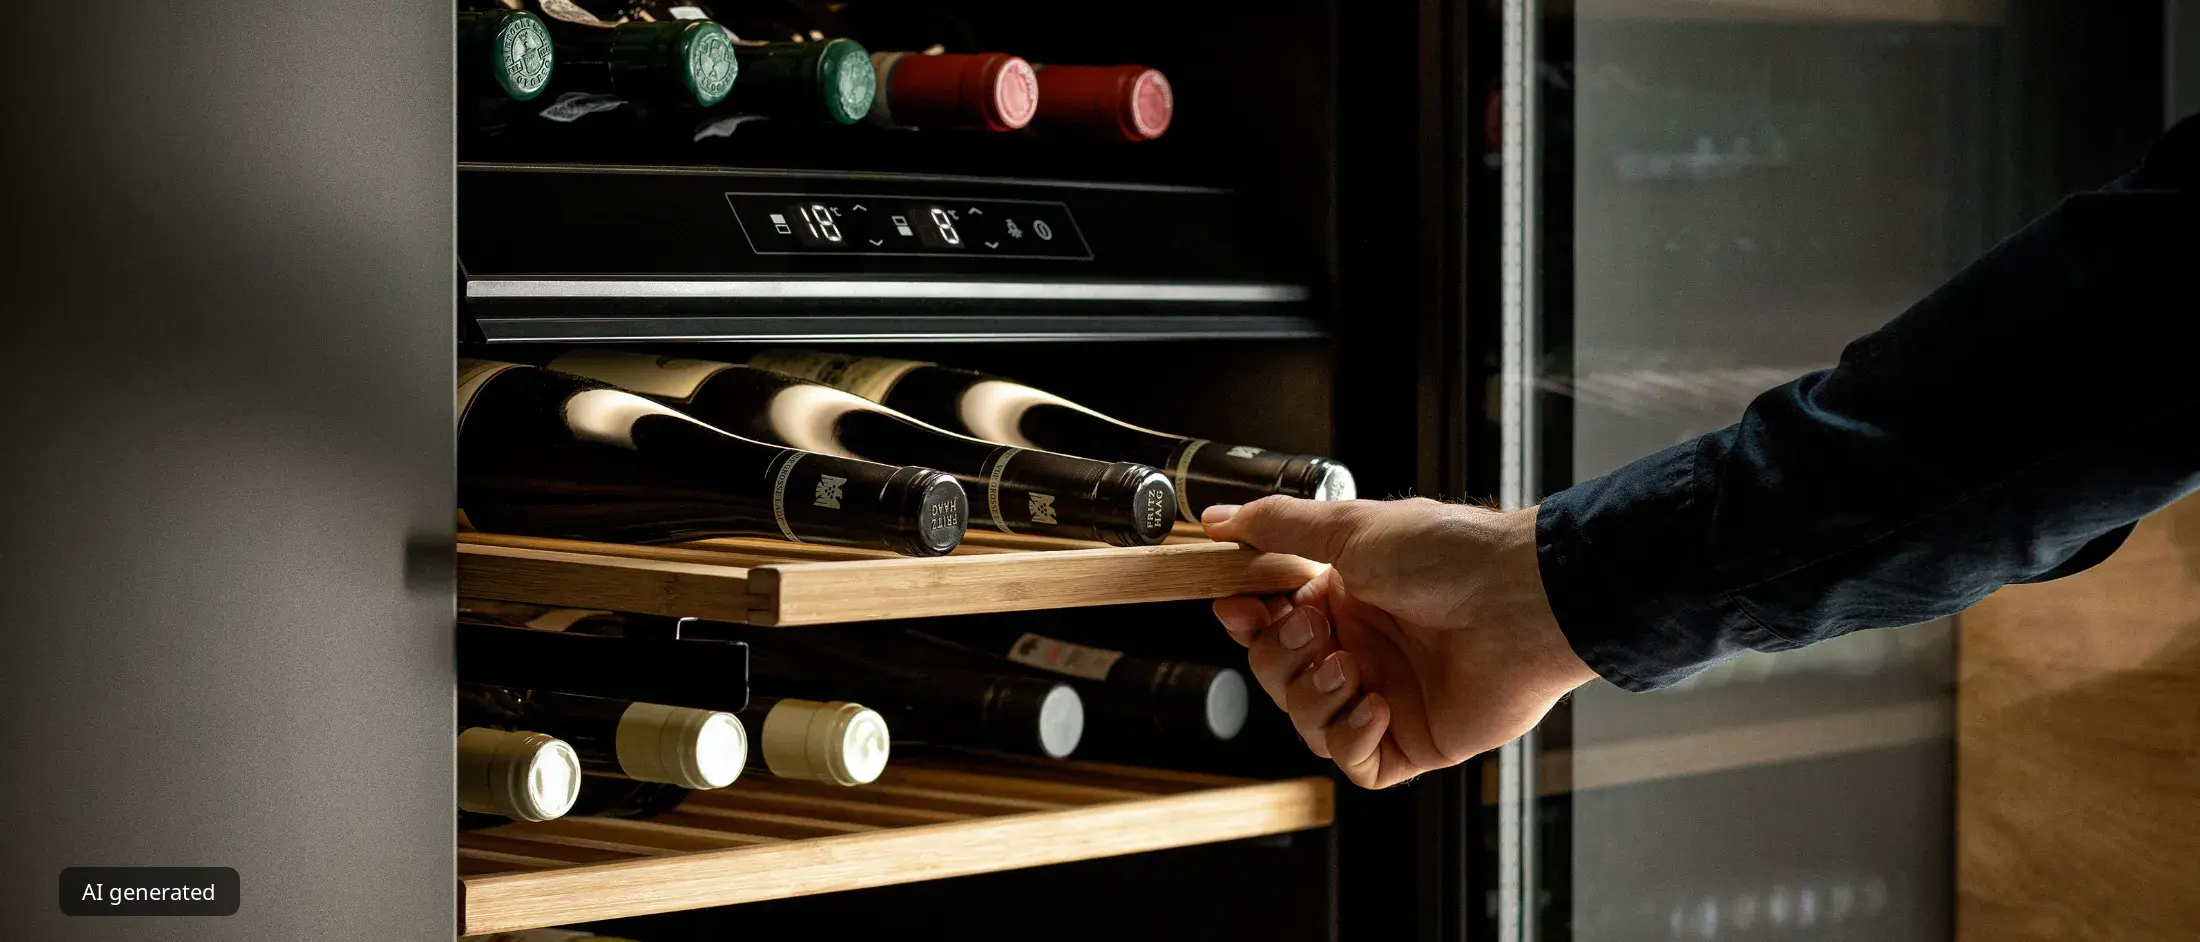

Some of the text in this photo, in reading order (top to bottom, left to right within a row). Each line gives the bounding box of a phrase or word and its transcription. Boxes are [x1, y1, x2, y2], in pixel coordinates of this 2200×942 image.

[800, 204, 842, 242] 18
[931, 208, 960, 244] 8
[774, 463, 791, 496] GROSSE
[932, 499, 957, 516] HAAG
[989, 482, 999, 515] GROSSE
[1147, 489, 1156, 528] FRITZ
[1154, 490, 1163, 528] HAAG
[931, 513, 957, 530] FRITZ
